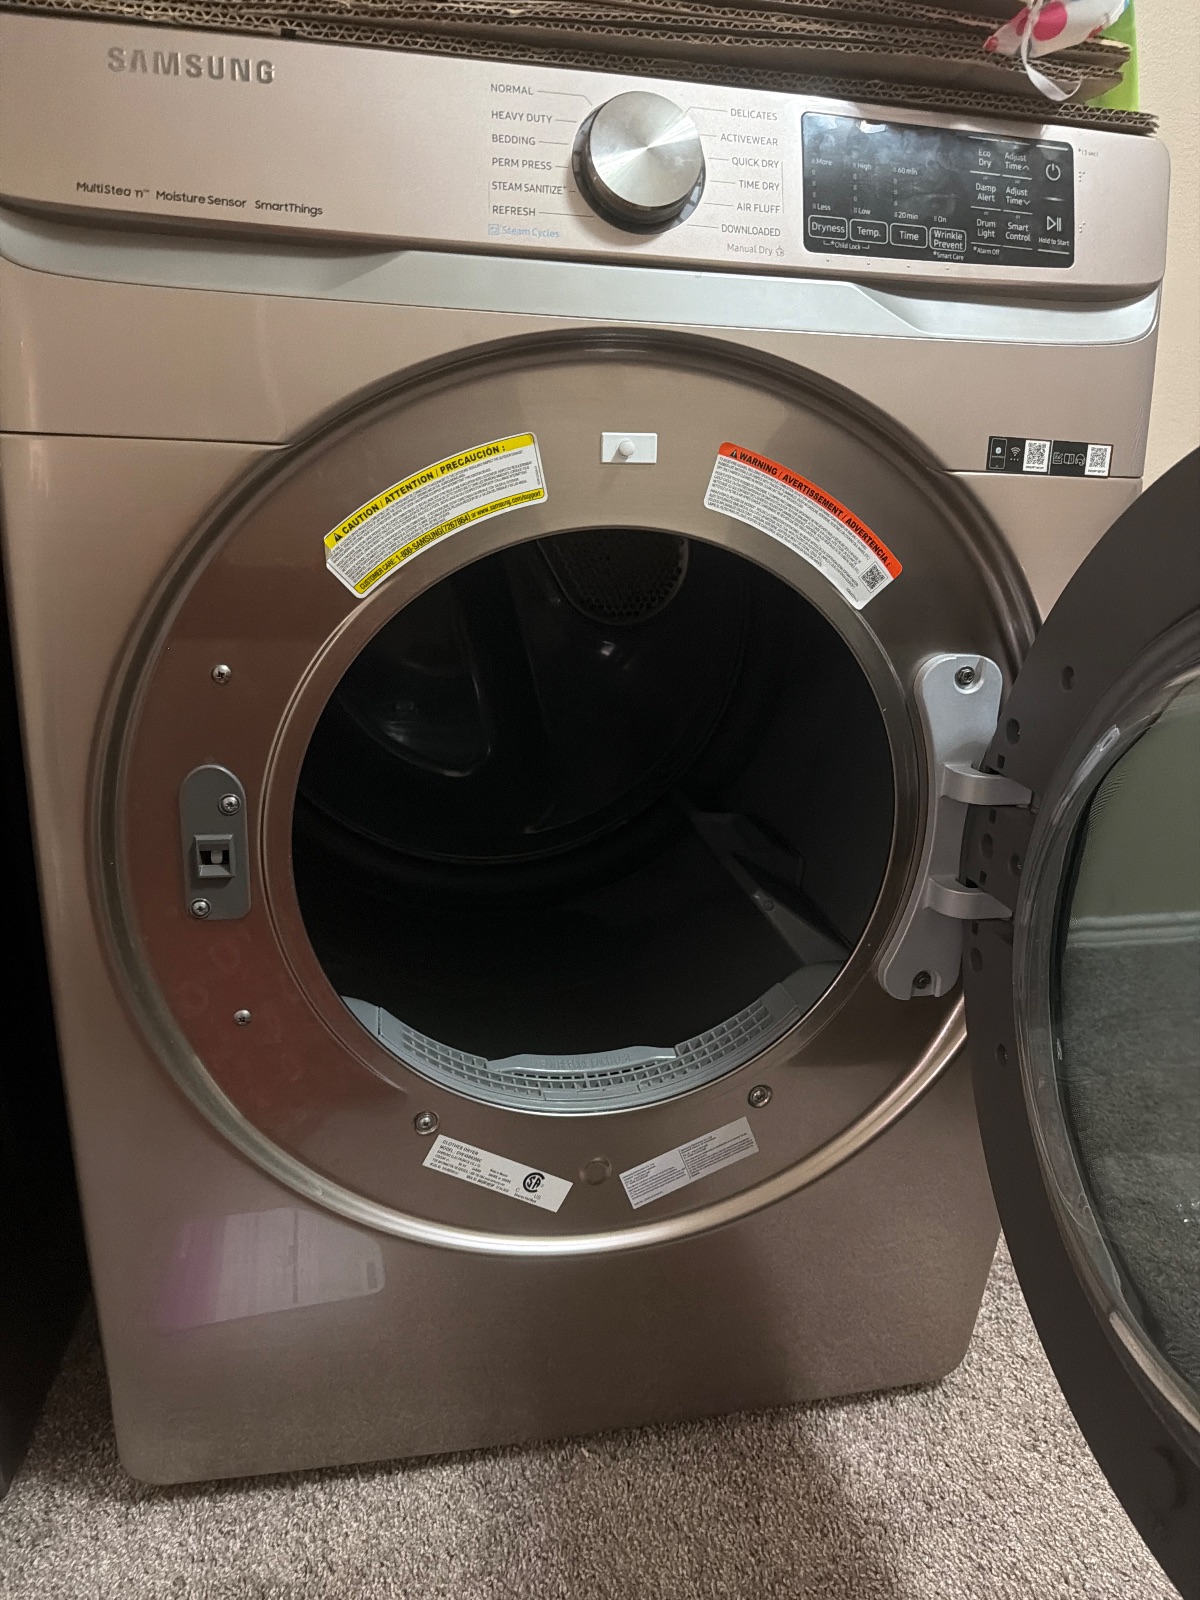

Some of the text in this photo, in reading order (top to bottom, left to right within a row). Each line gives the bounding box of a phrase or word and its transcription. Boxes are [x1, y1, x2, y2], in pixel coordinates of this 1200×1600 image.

[107, 46, 275, 84] SAMSUNG
[490, 83, 534, 96] NORMAL
[491, 110, 553, 123] HEAVY DUTY
[730, 108, 778, 121] DELICATES
[491, 133, 536, 146] BEDDING
[720, 133, 778, 146] ACTIVEWEAR
[978, 148, 991, 158] Eco
[1004, 152, 1027, 163] Adjust
[491, 157, 552, 171] PERM PRESS
[731, 156, 779, 168] QUICK DRY
[816, 158, 833, 166] More
[857, 163, 872, 171] High
[978, 158, 992, 168] Dry
[1005, 161, 1022, 171] Time
[491, 180, 522, 191] STEAM
[739, 179, 780, 191] TIME DRY
[975, 182, 997, 194] Damp
[977, 191, 995, 202] Alert
[1005, 186, 1028, 198] Adjust
[155, 189, 206, 205] Moisture
[207, 195, 247, 209] Sensor
[254, 199, 323, 218] SmartThings
[1006, 195, 1023, 205] Time
[492, 204, 536, 216] REFRESH
[737, 202, 781, 214] AIR FLUFF
[816, 203, 831, 211] Less
[858, 207, 871, 215] Low
[937, 215, 947, 223] On
[976, 218, 996, 228] Drum
[502, 224, 560, 239] Steam Cycles
[721, 223, 781, 237] DOWNLOADED
[811, 221, 846, 234] Dryness
[856, 226, 882, 238] Temp.
[1007, 221, 1029, 232] Smart
[899, 230, 919, 241] Time
[933, 229, 963, 241] Wrinkle
[977, 227, 996, 239] Light
[1005, 231, 1031, 242] Control
[933, 239, 964, 250] Prevent
[1038, 237, 1051, 245] Hold
[1057, 238, 1070, 247] Start
[727, 243, 773, 257] Manual Dry
[992, 248, 1000, 256] Off
[952, 253, 965, 261] Care
[341, 503, 380, 534] CAUTION
[384, 471, 435, 505] ATTENTION
[439, 445, 500, 475] PRECAUCIÓN
[739, 450, 778, 476] WARNING
[782, 473, 844, 518] AVERTISSEMENT
[845, 517, 888, 563] ADVERTENCIA
[359, 567, 383, 590] CUSTOMER
